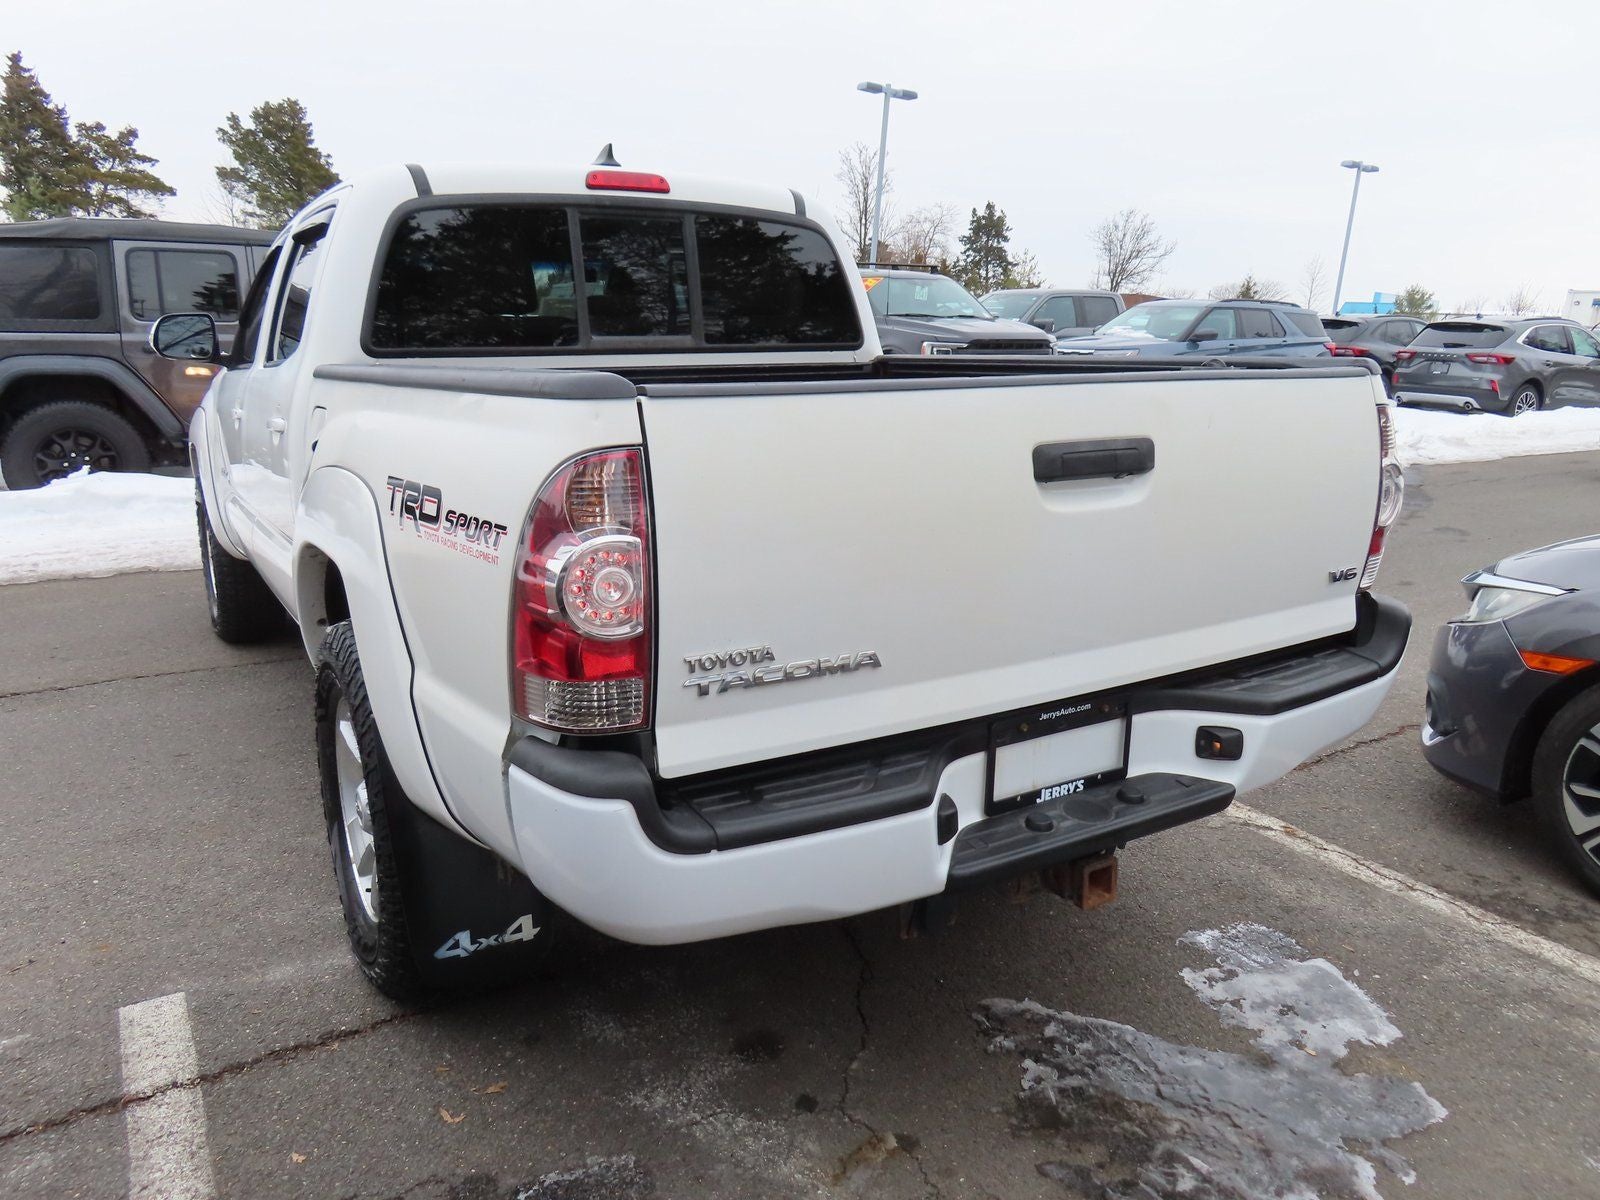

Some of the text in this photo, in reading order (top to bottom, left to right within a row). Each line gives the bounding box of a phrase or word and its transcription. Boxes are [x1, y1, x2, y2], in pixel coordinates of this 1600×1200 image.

[387, 475, 508, 551] TRD SPORT
[423, 531, 500, 566] TOYOTA RACING DEVELOPMENT
[1328, 567, 1357, 583] V6
[682, 650, 882, 697] TACOMA
[684, 643, 776, 673] TOYOTA
[1038, 702, 1092, 721] JerrysAuto.com
[1036, 779, 1085, 804] JERRY'S
[433, 913, 541, 960] 4x4
